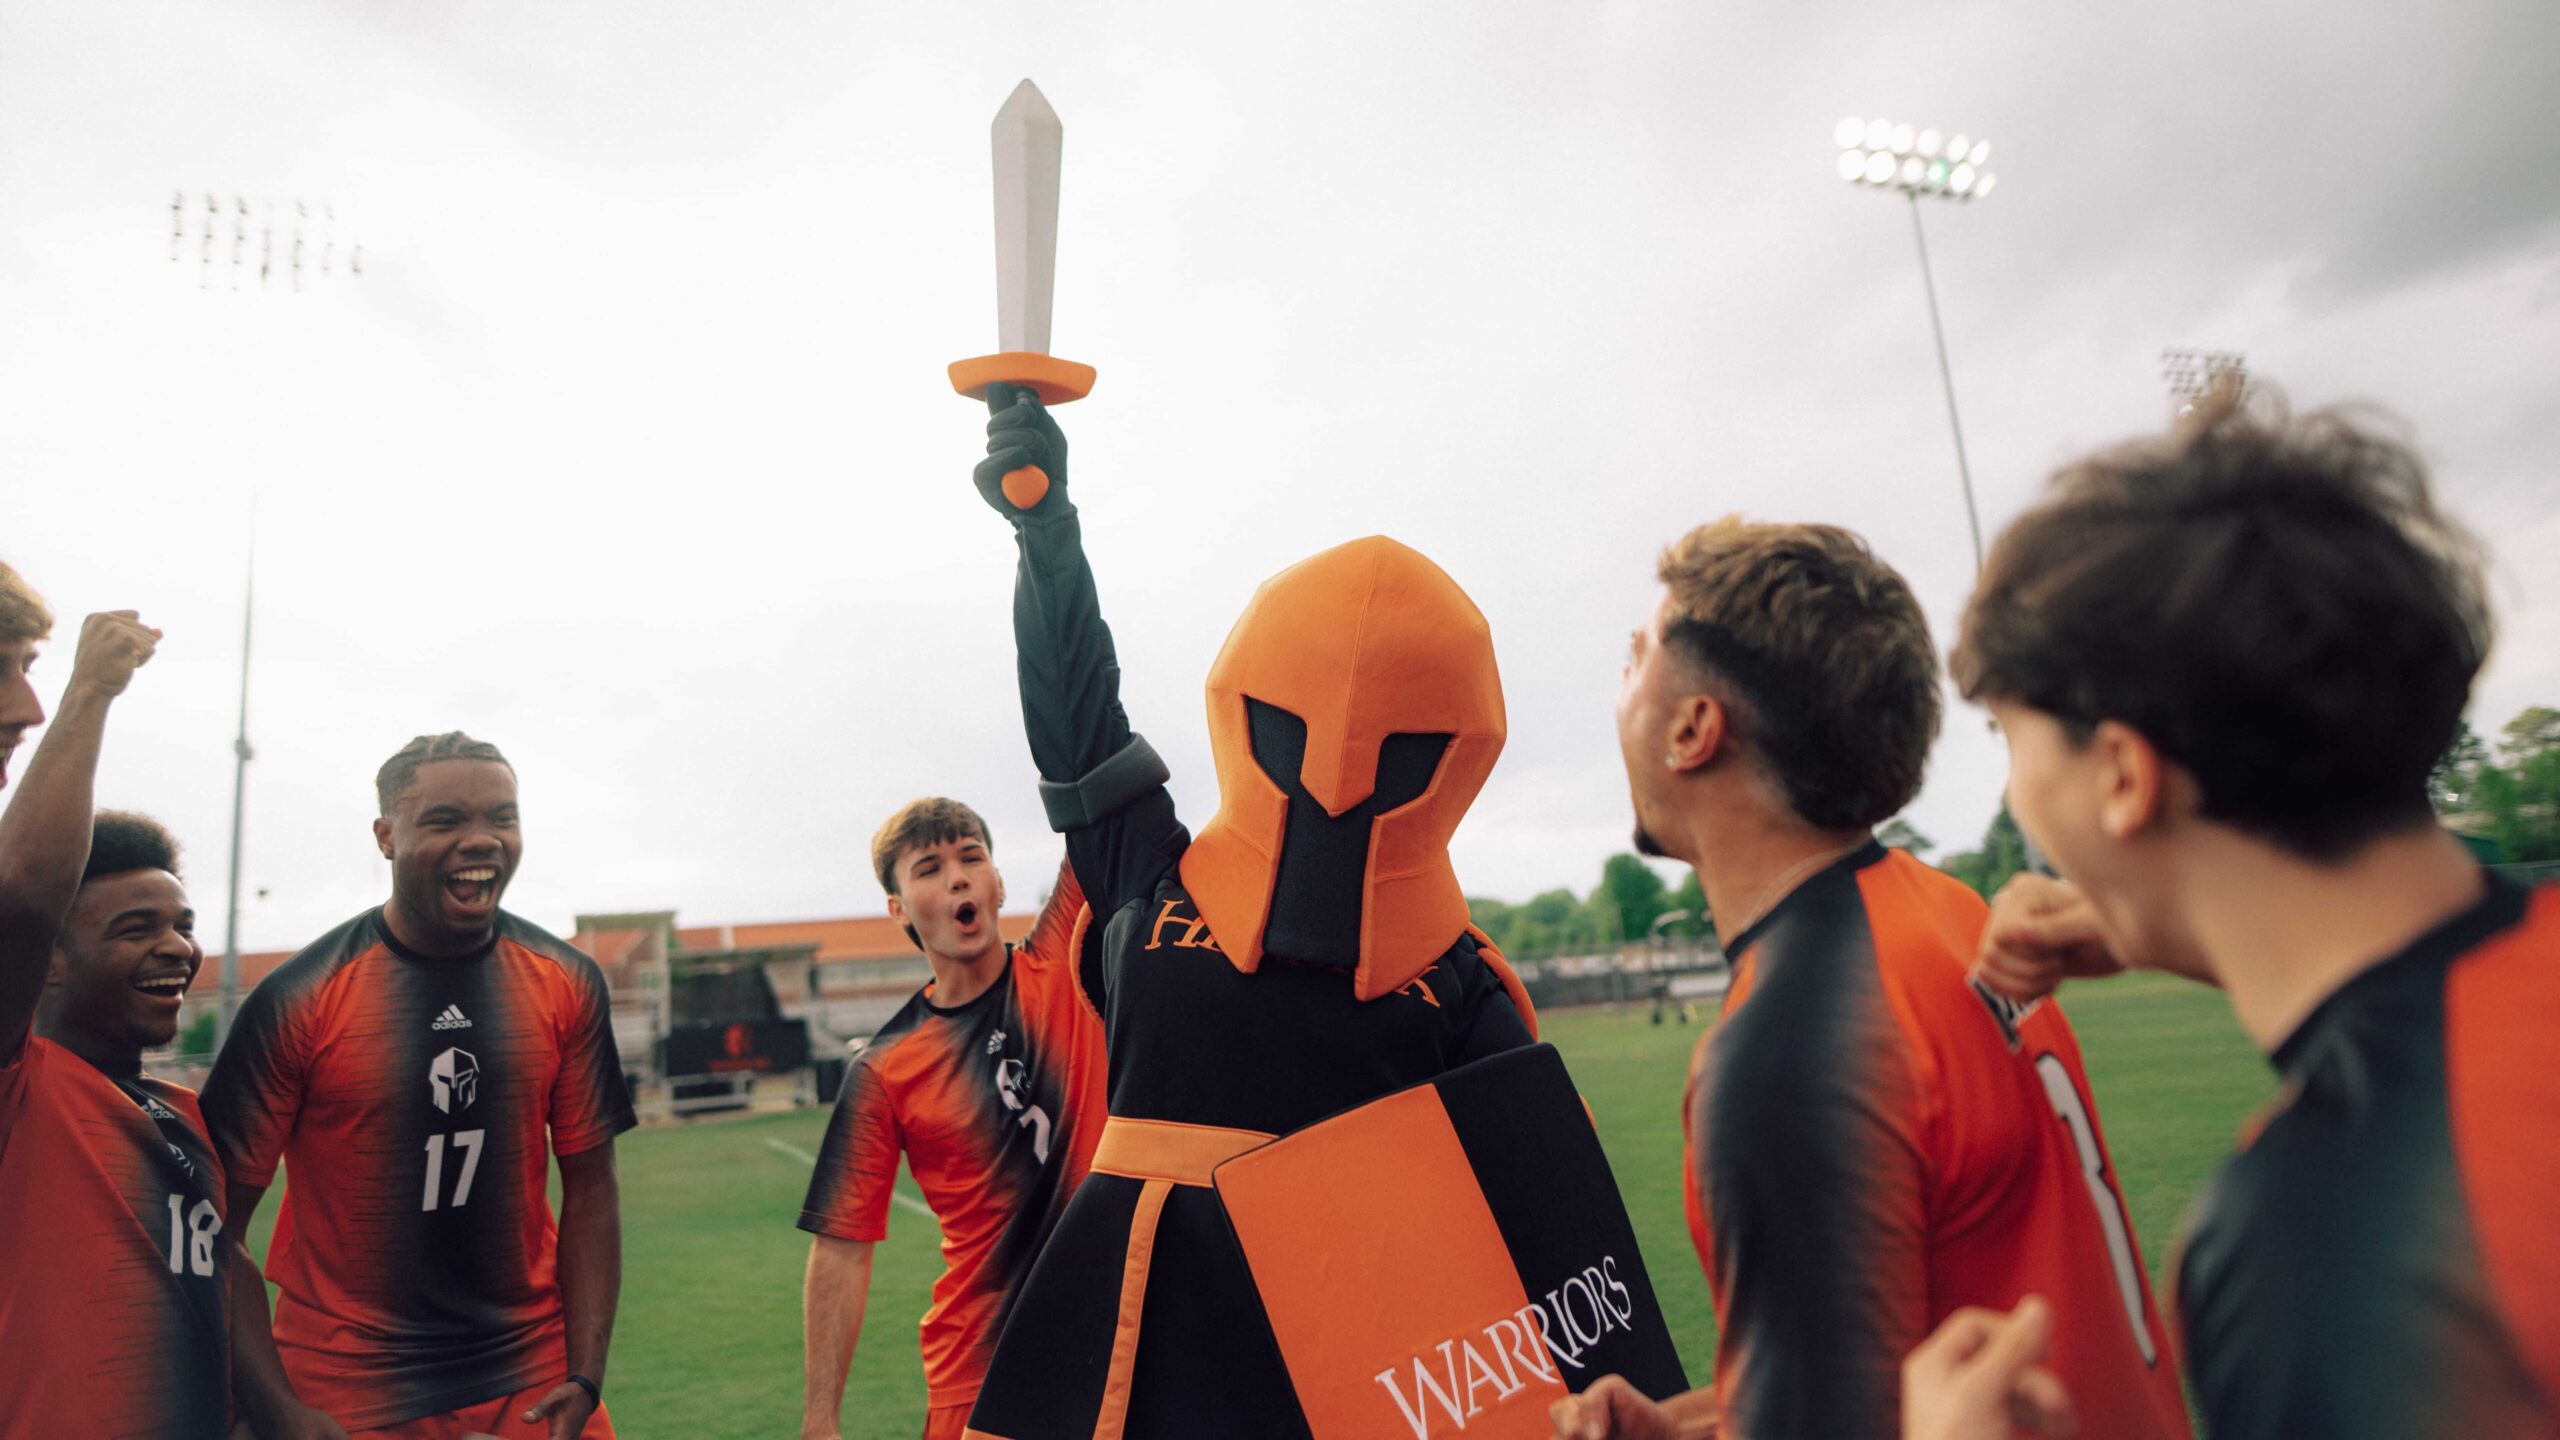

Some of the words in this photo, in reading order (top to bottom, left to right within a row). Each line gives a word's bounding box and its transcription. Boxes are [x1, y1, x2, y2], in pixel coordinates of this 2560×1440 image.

[431, 1018, 473, 1031] adidas
[422, 1129, 485, 1212] 17
[168, 1193, 224, 1277] 18
[1375, 1255, 1632, 1440] WARRIORS
